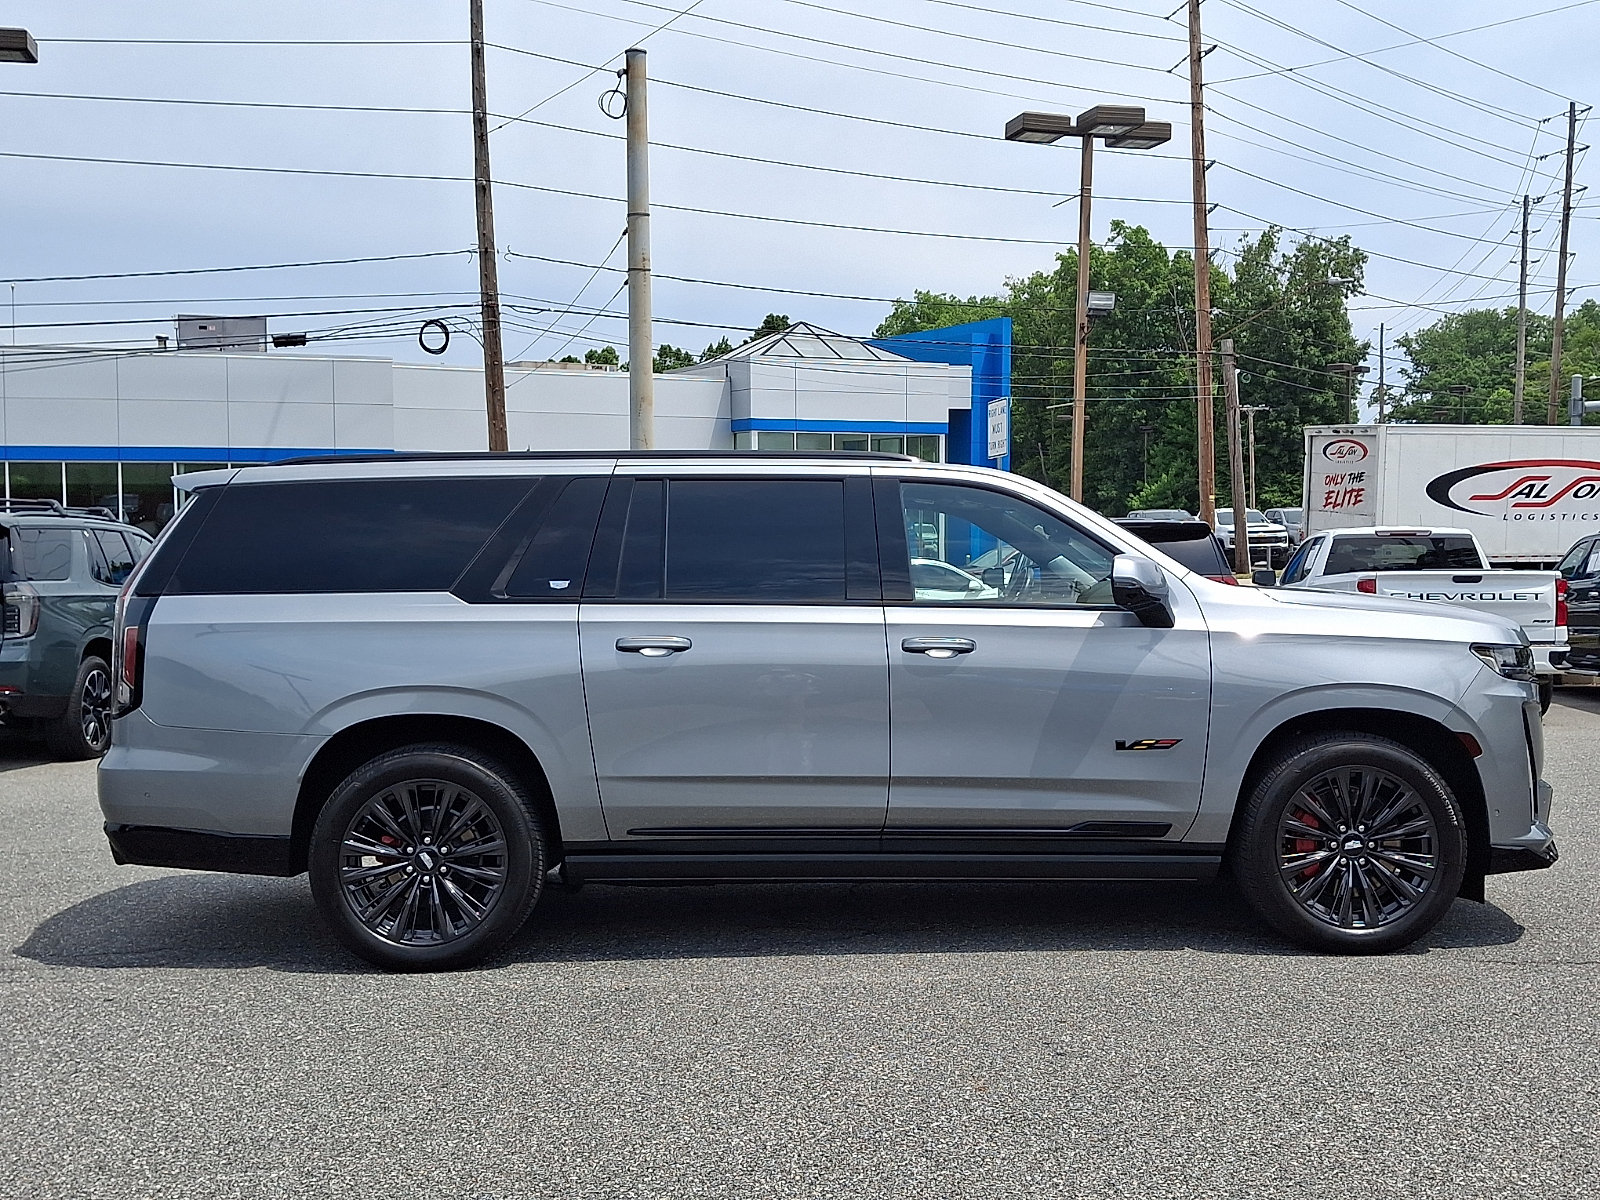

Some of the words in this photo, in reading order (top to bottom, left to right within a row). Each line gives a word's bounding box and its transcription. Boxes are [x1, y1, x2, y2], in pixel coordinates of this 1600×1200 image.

[989, 408, 997, 418] RIGHT
[998, 405, 1006, 415] LANE
[992, 422, 1003, 434] MUST
[1324, 473, 1346, 487] ONLY
[1348, 471, 1366, 485] THE
[1323, 487, 1365, 509] ELITE
[1502, 513, 1599, 521] LOGISTICS
